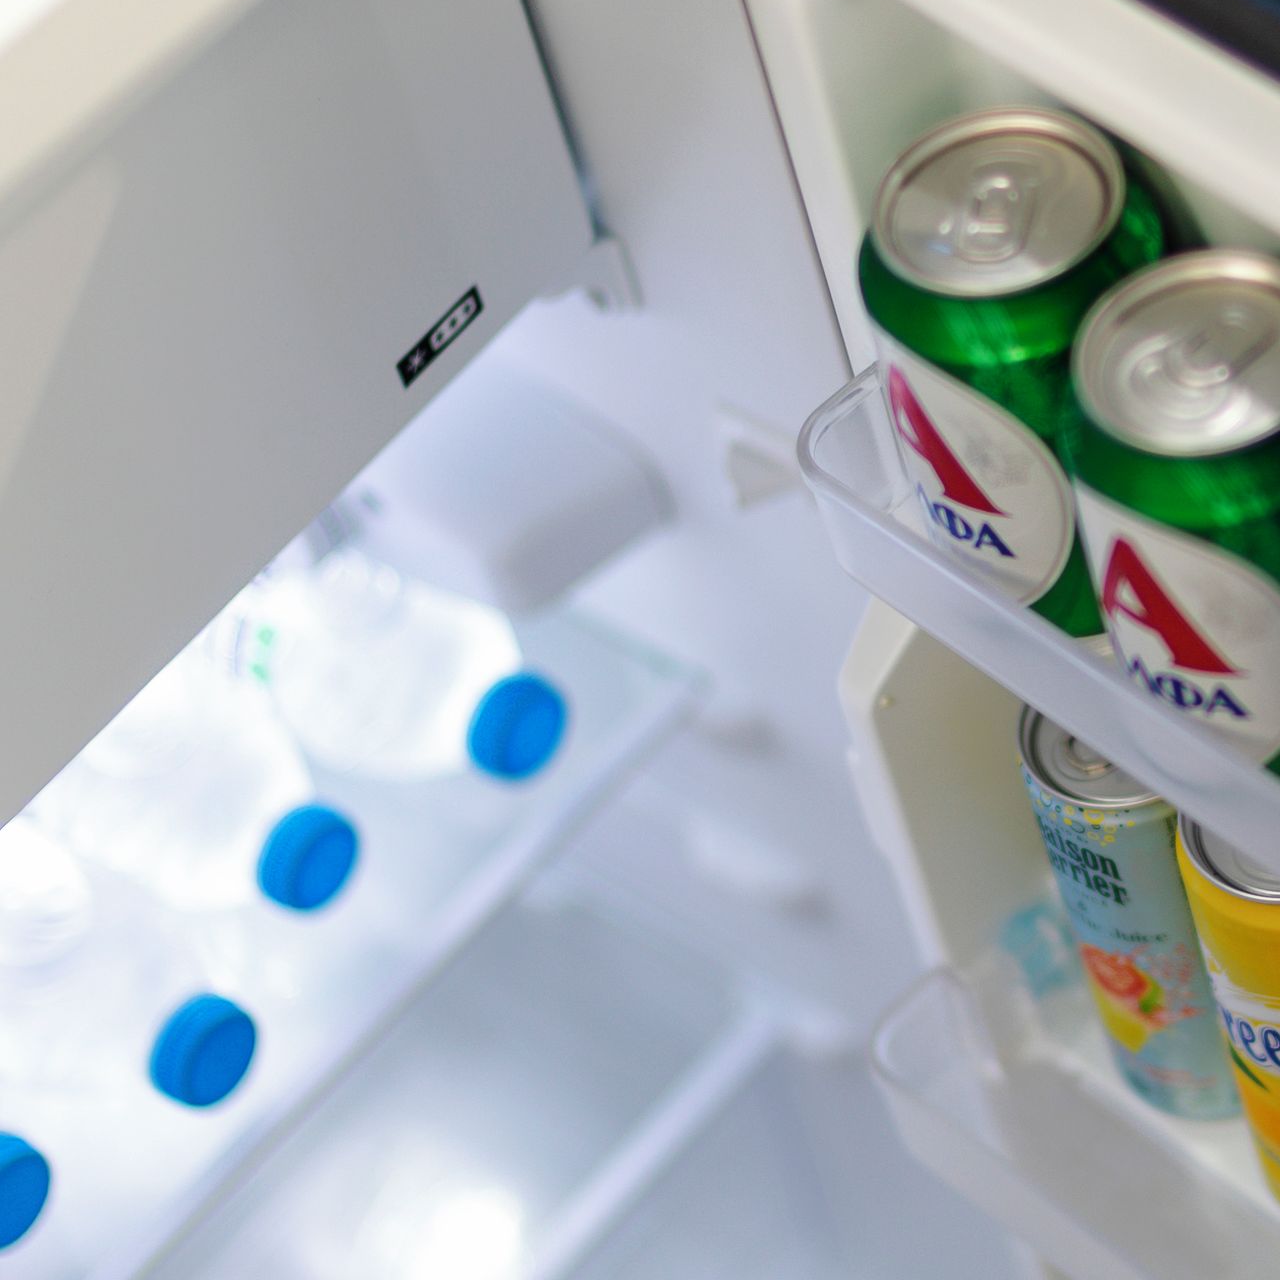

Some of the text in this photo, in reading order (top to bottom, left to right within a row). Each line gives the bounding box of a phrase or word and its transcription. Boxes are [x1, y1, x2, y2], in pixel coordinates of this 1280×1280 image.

[916, 482, 1016, 558] ΛΦΑ
[1129, 656, 1250, 719] ΛΦΑ
[1040, 824, 1122, 881] aison
[1050, 853, 1129, 906] errier
